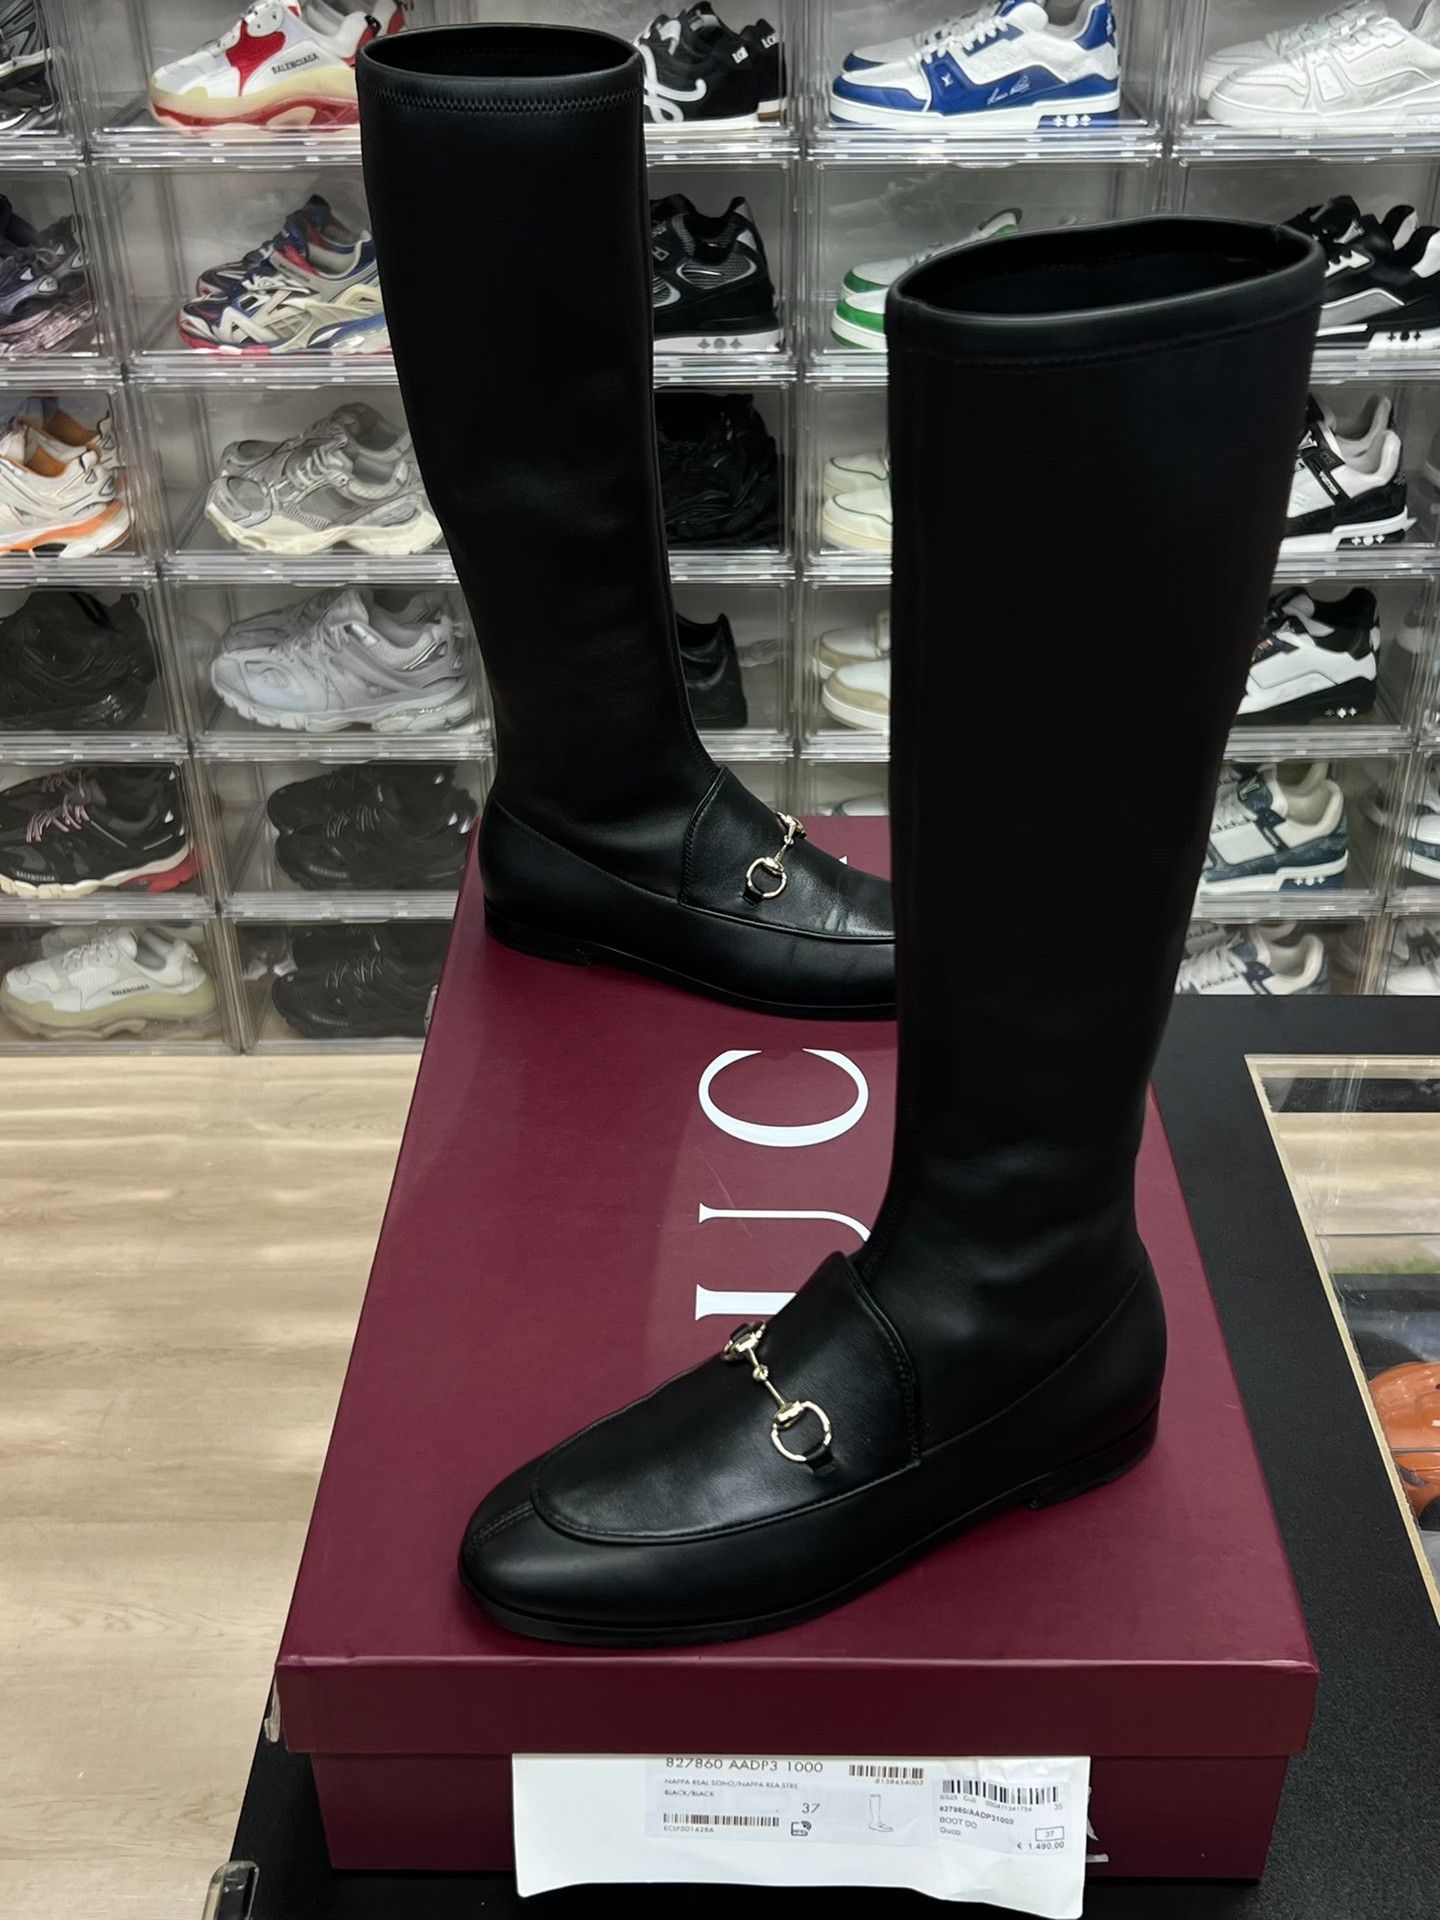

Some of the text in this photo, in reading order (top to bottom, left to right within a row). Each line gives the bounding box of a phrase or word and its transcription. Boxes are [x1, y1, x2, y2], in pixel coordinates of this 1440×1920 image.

[666, 1757, 824, 1773] 827860 AADP3 1000
[664, 1789, 715, 1798] BLACK/BLACK
[801, 1803, 821, 1814] 37
[939, 1816, 963, 1826] BOOT
